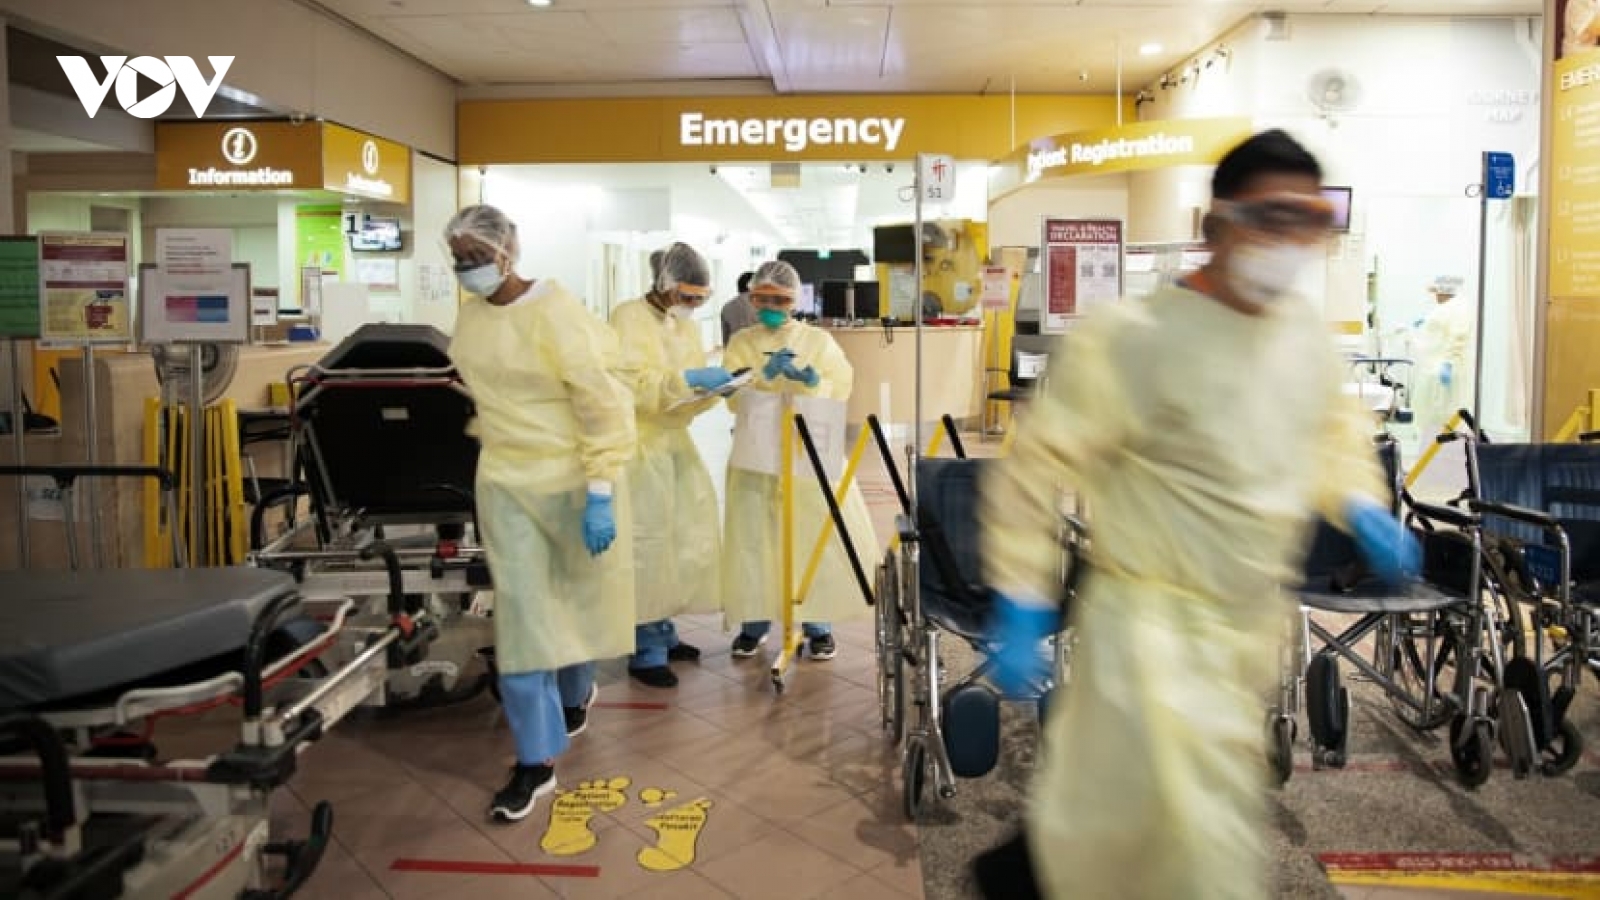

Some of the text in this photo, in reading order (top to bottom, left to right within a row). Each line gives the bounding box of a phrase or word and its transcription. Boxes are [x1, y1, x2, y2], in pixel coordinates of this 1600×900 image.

[680, 112, 905, 151] Emergency
[1071, 133, 1193, 165] Registration
[188, 167, 294, 185] Information
